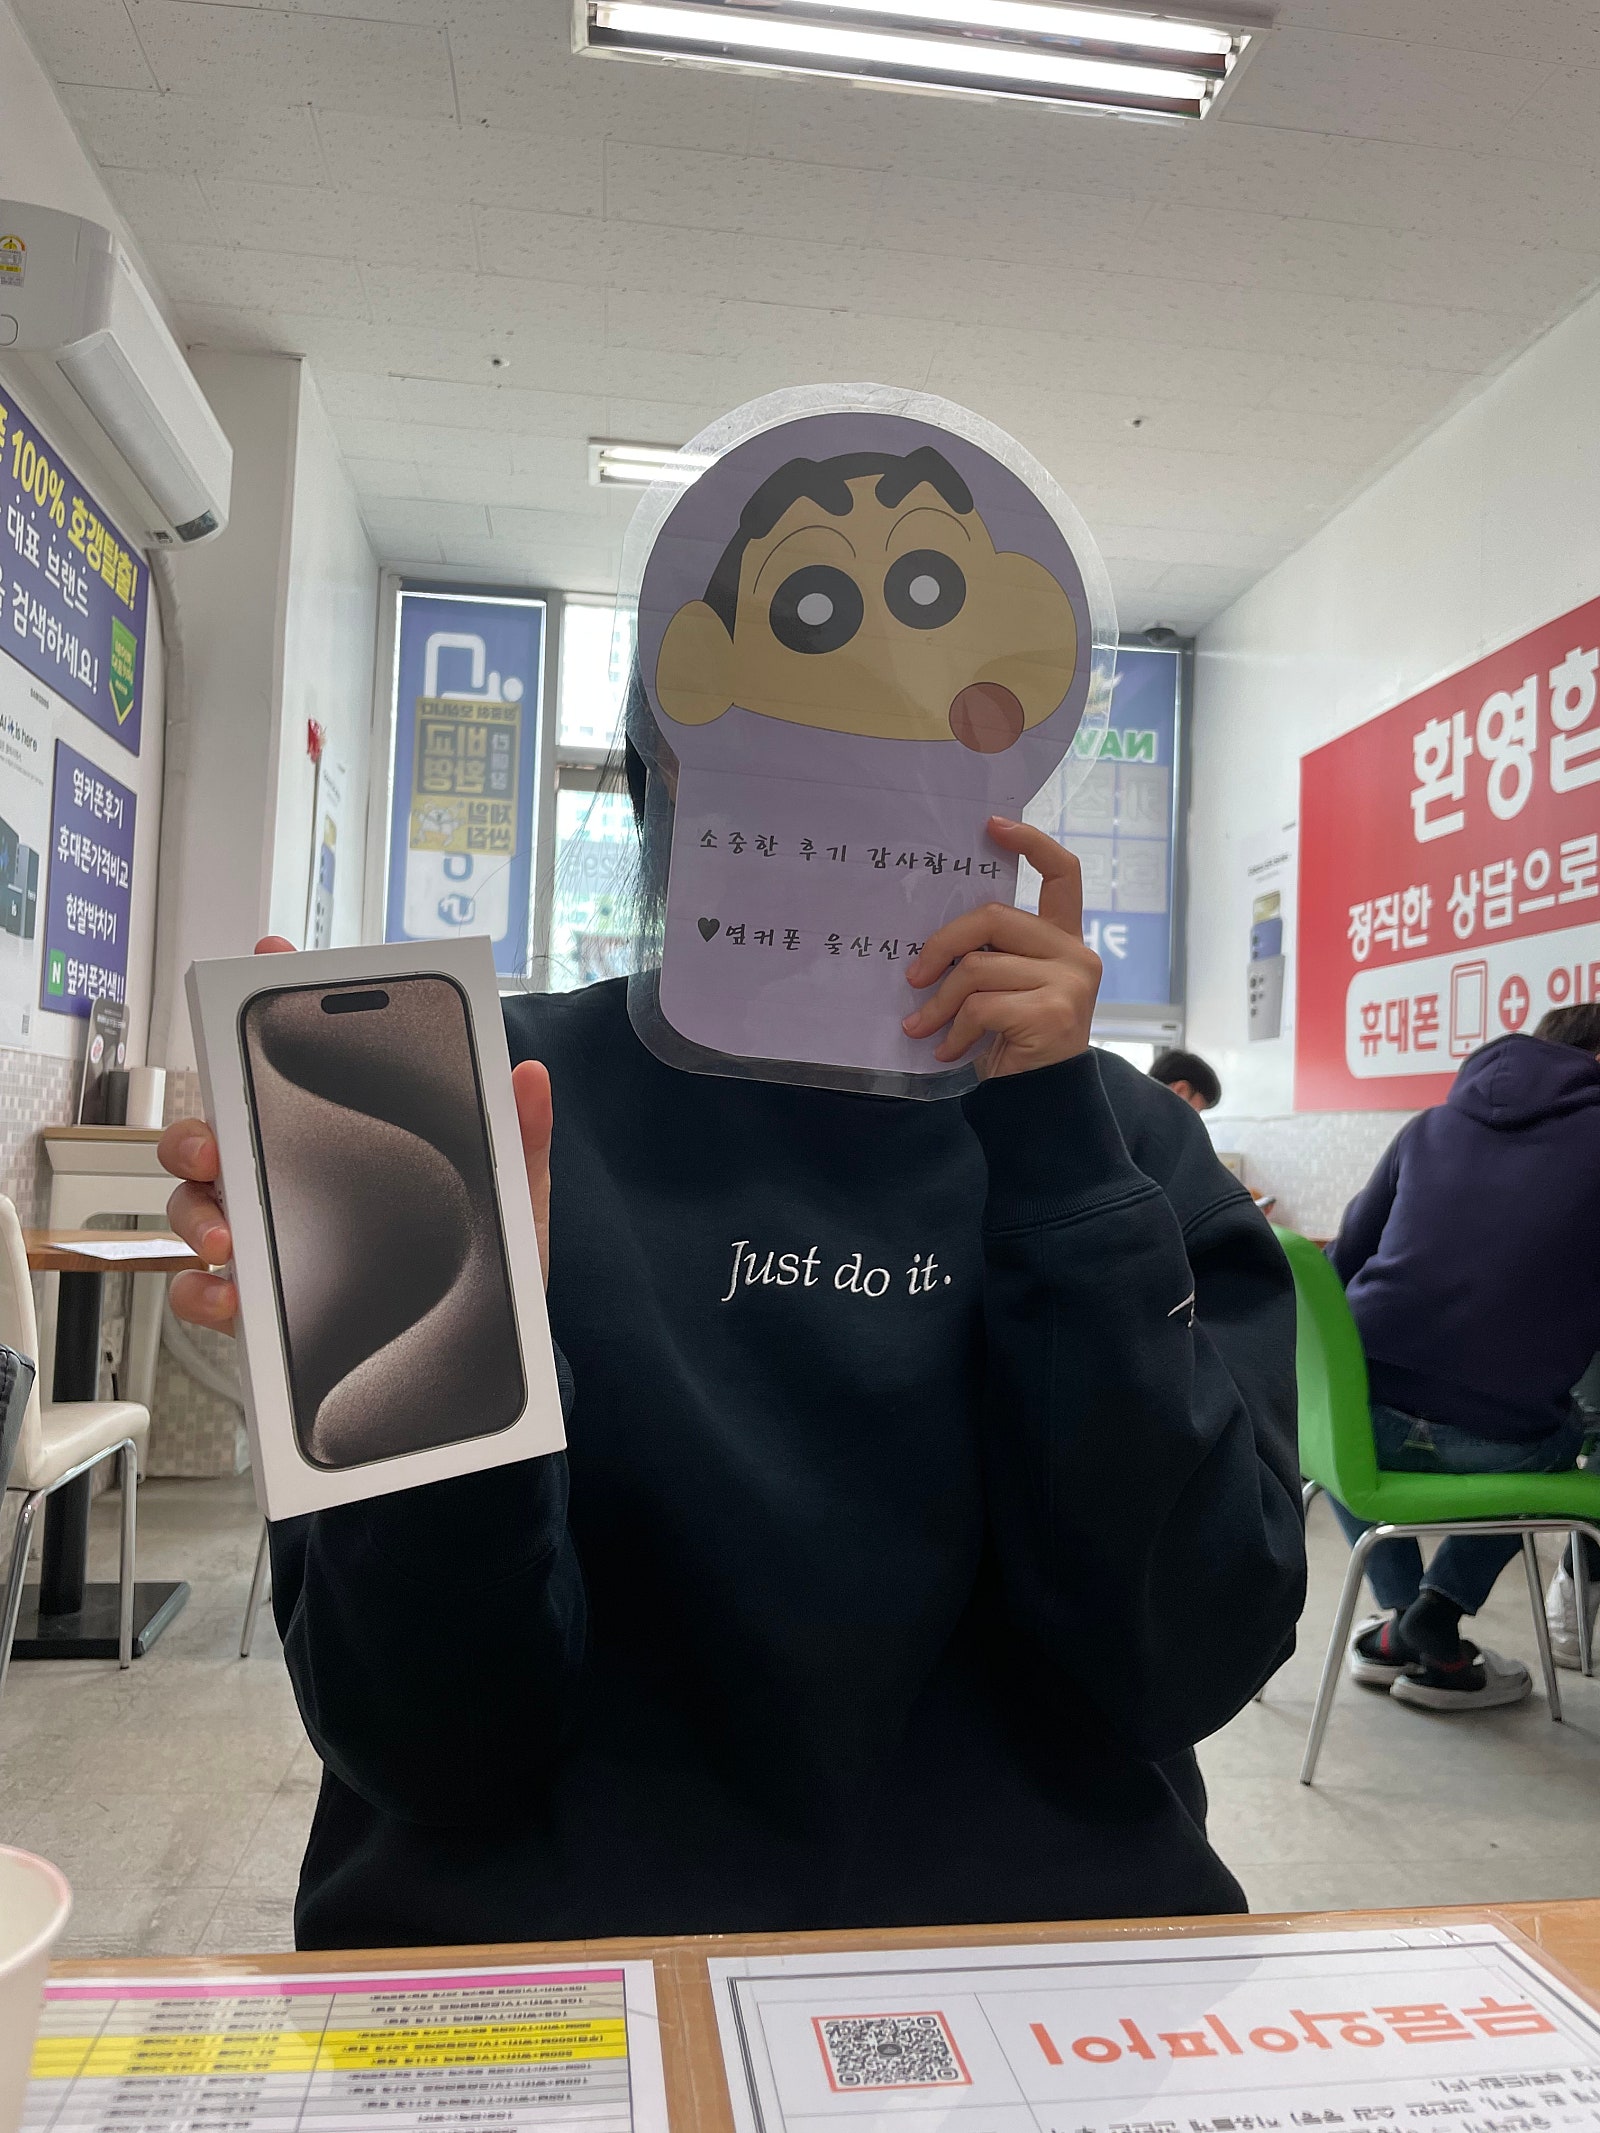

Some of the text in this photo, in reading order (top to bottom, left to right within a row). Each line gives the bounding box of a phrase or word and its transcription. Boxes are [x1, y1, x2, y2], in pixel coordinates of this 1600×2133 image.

[12, 429, 139, 611] 100% 호갱탈출!
[7, 504, 90, 618] 대표 브랜드
[12, 580, 98, 695] 검색하세요!
[72, 767, 124, 829] 옆커폰후기
[57, 825, 130, 889] 휴대폰가격비교
[699, 829, 1001, 880] 소중한 후기 감사합니다
[65, 894, 118, 945] 현찰박치기
[1347, 833, 1599, 963] 정직한 상담으로
[725, 923, 801, 951] 옆커폰
[1359, 993, 1442, 1059] 휴대폰
[721, 1240, 952, 1302] Just do it.
[1029, 1995, 1557, 2066] 무료와이파이
